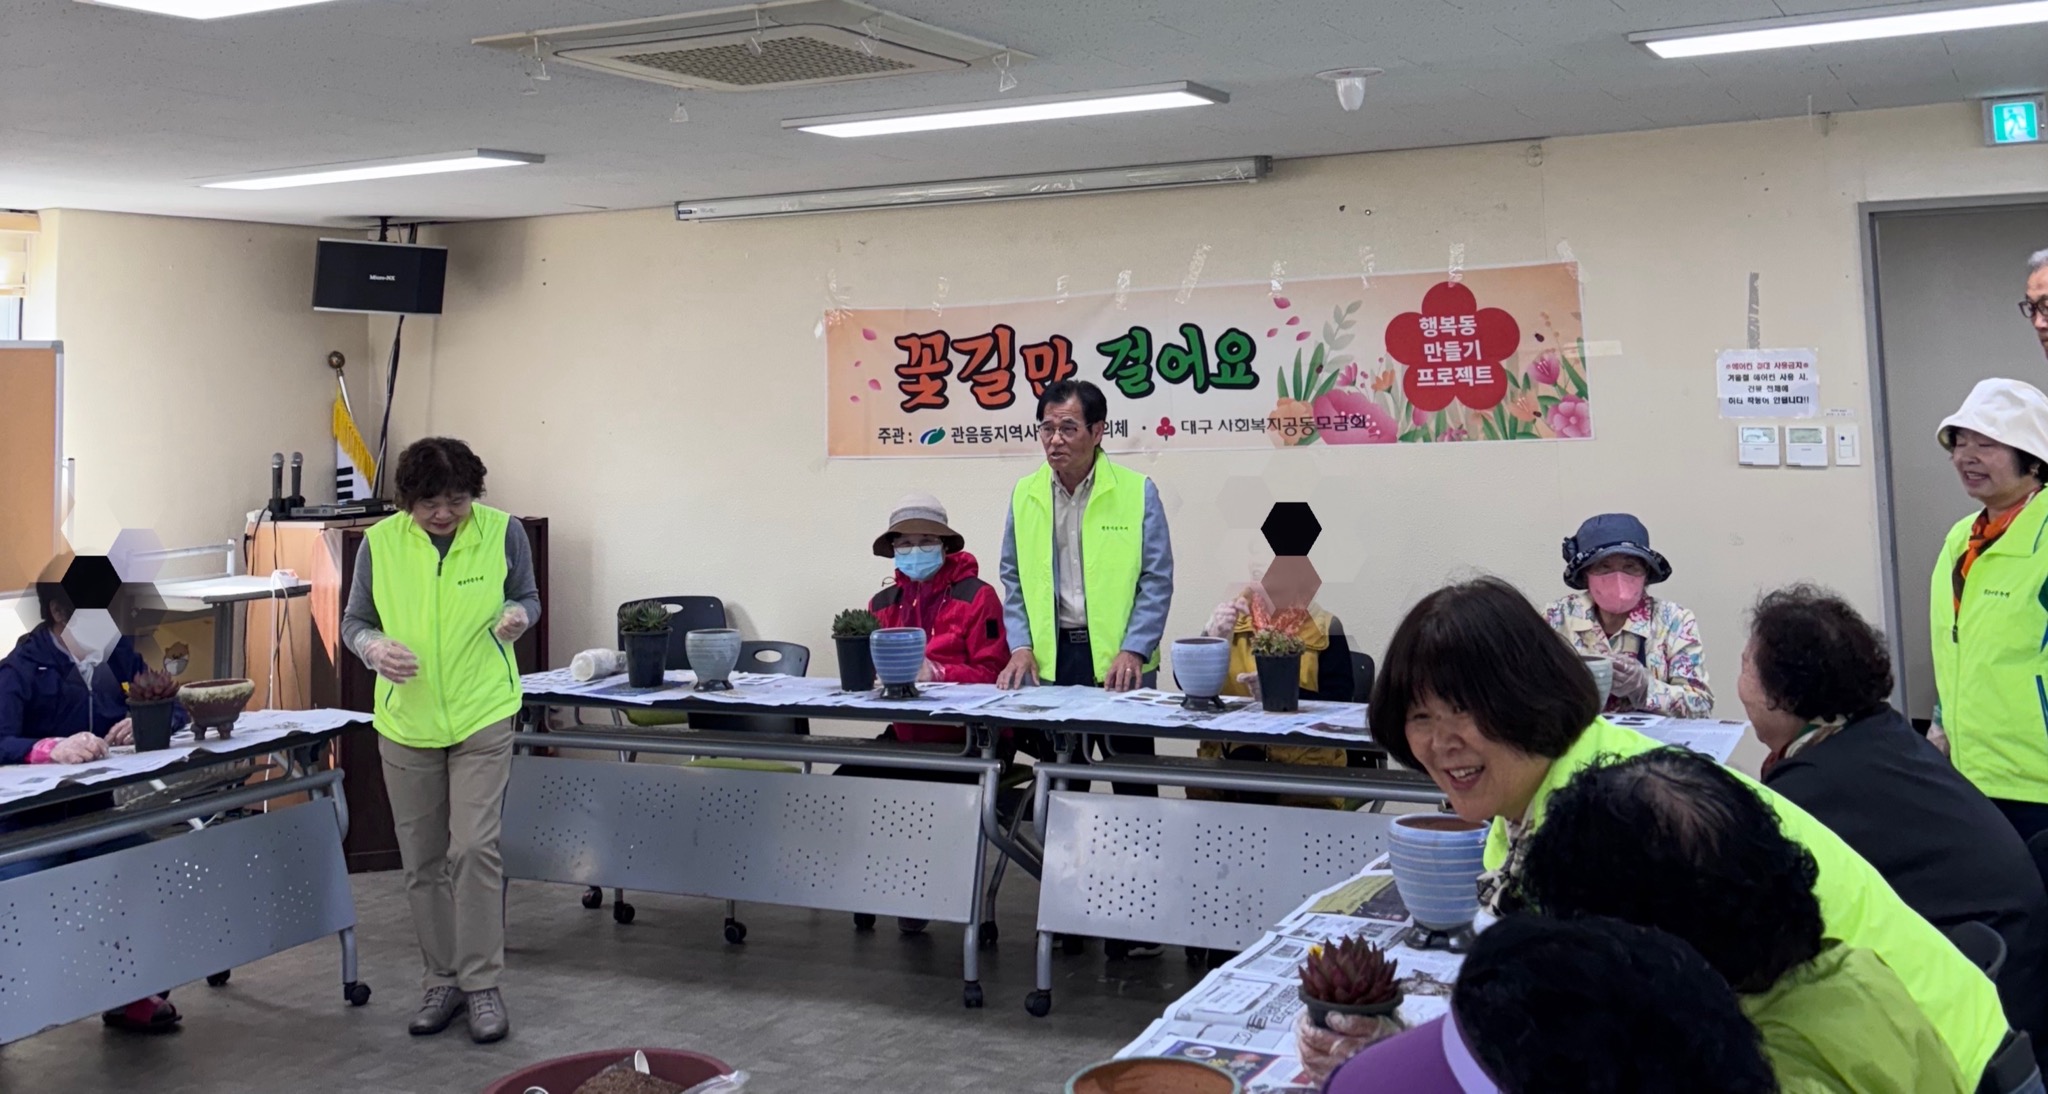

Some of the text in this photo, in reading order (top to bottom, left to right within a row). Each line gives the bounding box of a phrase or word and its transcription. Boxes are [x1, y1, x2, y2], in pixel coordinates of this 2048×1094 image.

[1419, 315, 1477, 338] 행복동
[1423, 339, 1482, 363] 만들기
[894, 323, 1260, 413] 꽃길만 걸어요
[1417, 366, 1494, 387] 프로젝트
[1181, 419, 1214, 435] 대구
[1218, 414, 1367, 436] 사회복지공동모금회
